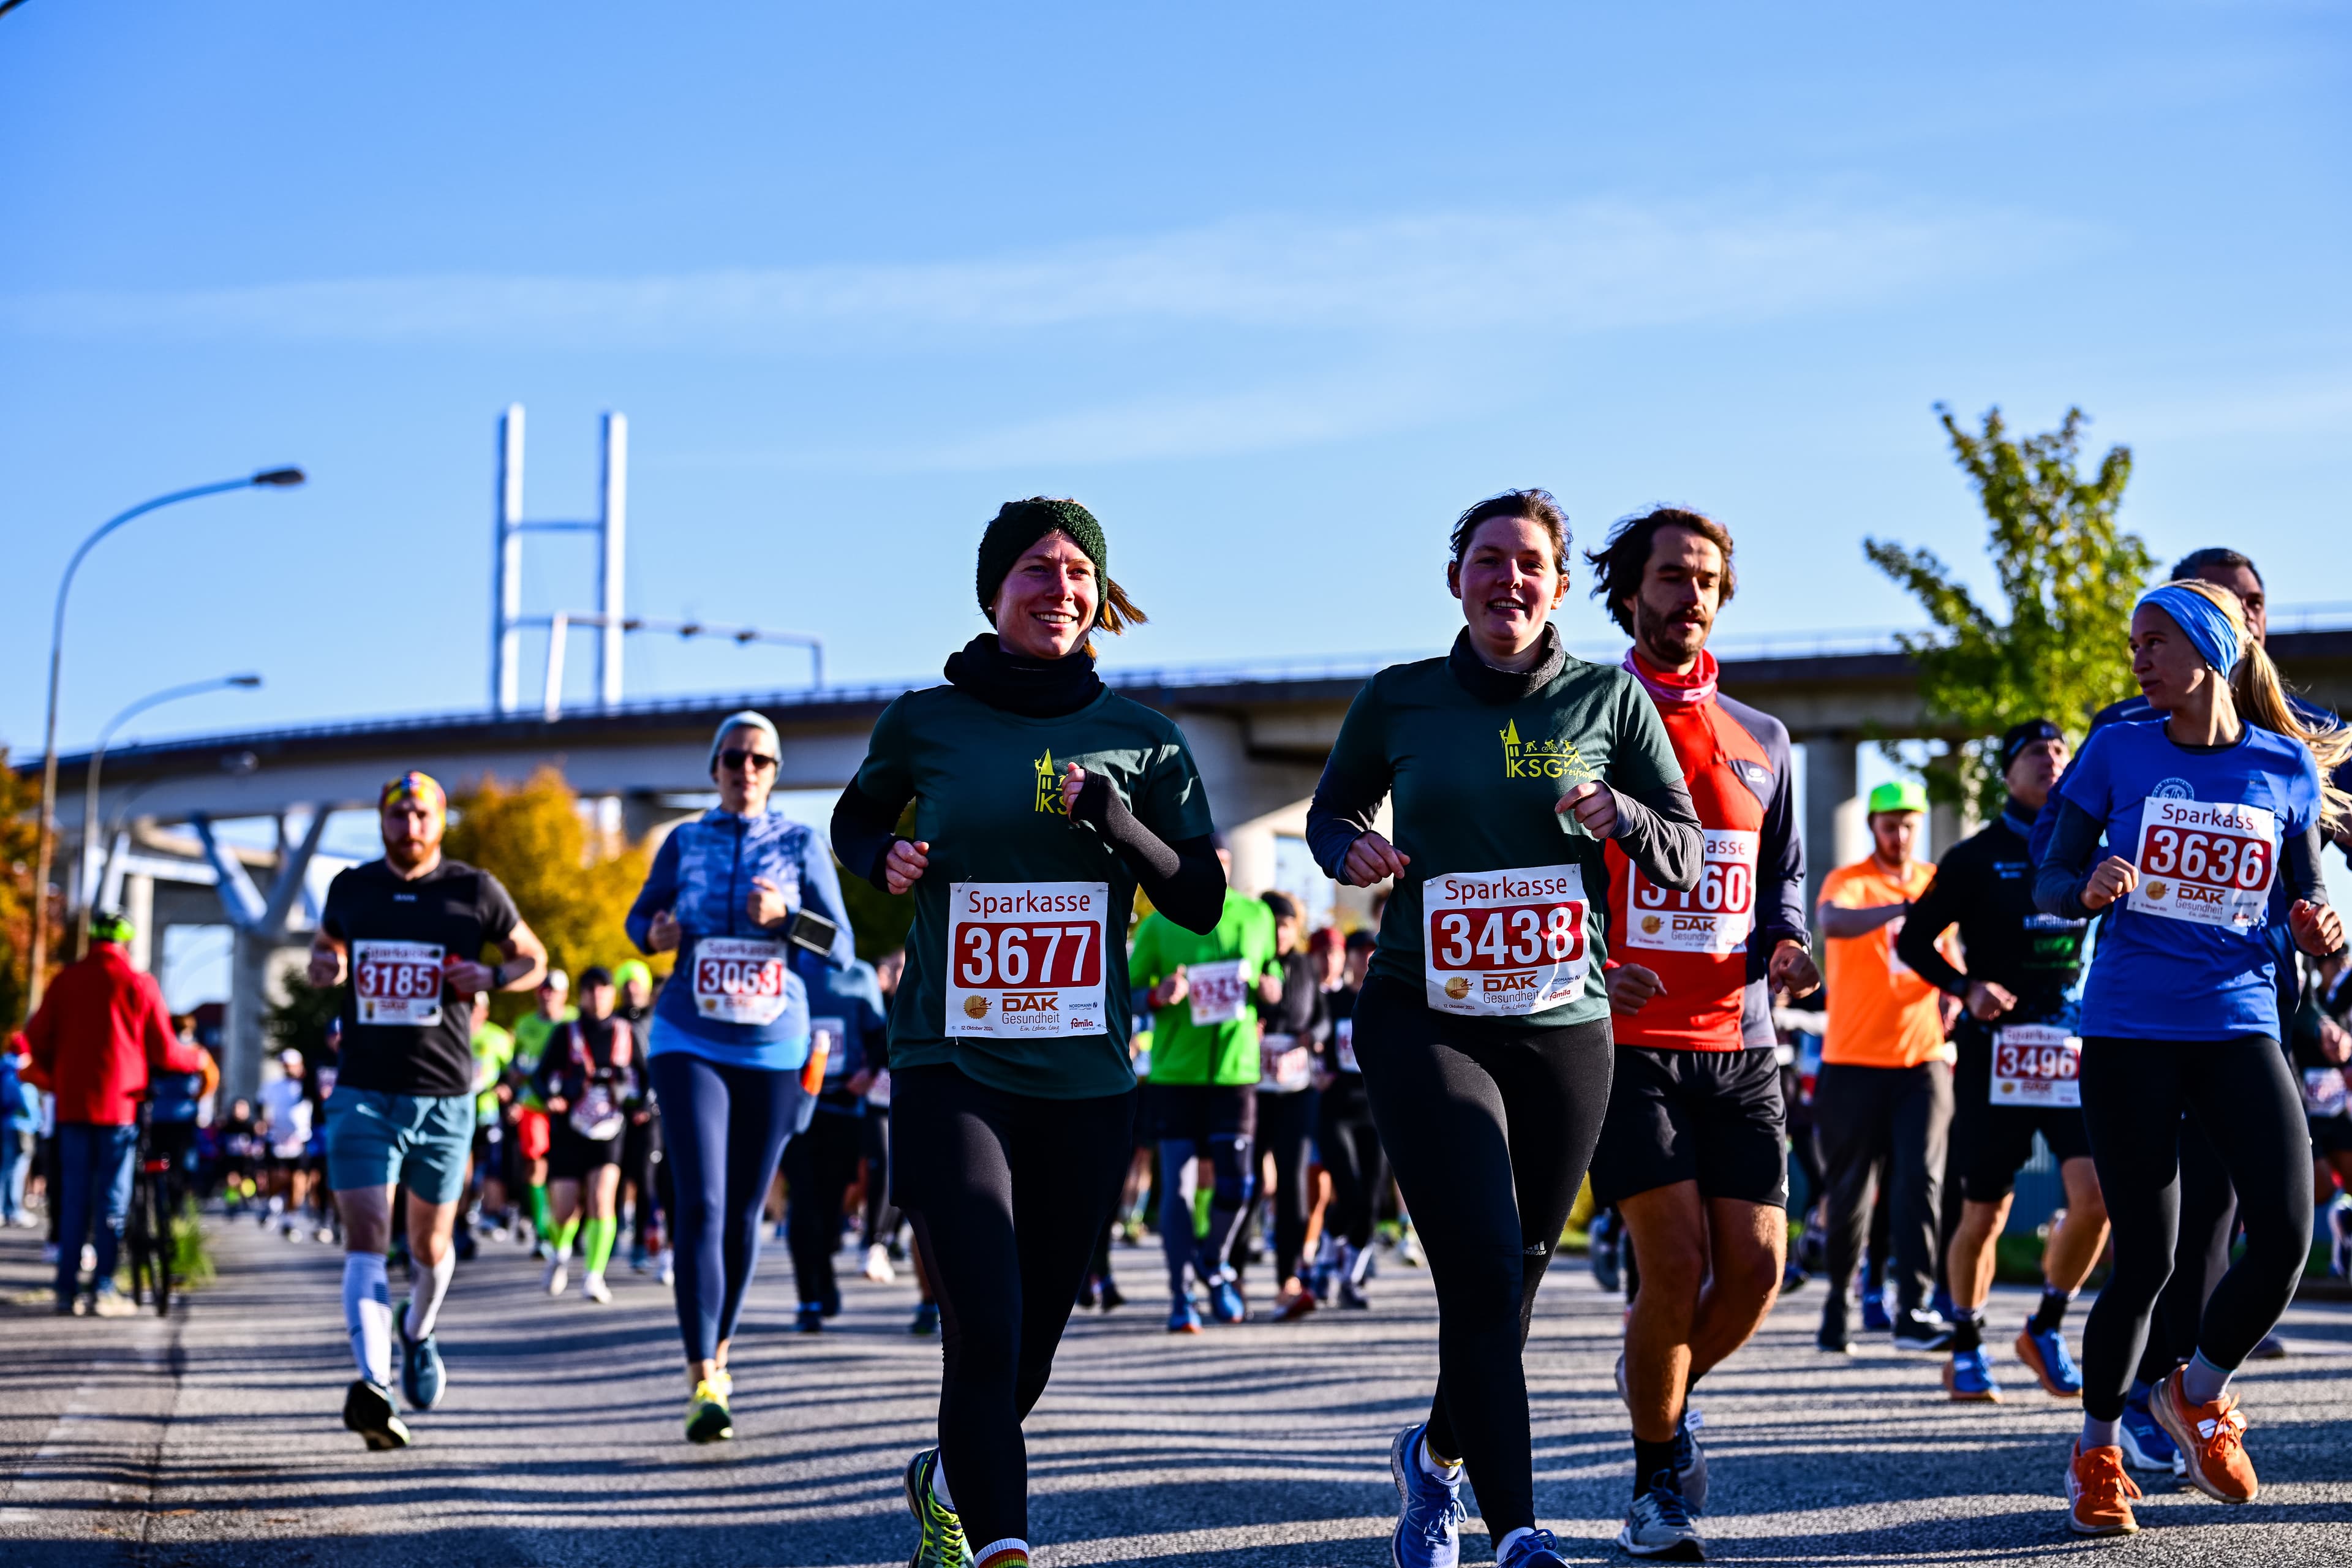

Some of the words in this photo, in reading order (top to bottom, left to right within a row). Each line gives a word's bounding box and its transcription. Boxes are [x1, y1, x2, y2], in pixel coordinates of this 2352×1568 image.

[2162, 804, 2255, 830] Sparkass
[2149, 829, 2264, 888] 3636
[1445, 876, 1567, 905] Sparkasse
[2177, 883, 2226, 905] DAK
[968, 889, 1091, 919] Sparkasse
[2176, 899, 2223, 914] Gesundheit
[1672, 914, 1717, 932] DAK
[1441, 907, 1575, 966] 3438
[1671, 930, 1717, 941] Gesundh
[962, 926, 1091, 984] 3677
[361, 965, 433, 997] 3185
[703, 960, 778, 996] 3063
[1483, 970, 1539, 992] DAK
[1002, 992, 1059, 1011] DAK
[1483, 989, 1539, 1004] Gesundheit
[1550, 989, 1571, 1001] famila
[1002, 1012, 1060, 1024] Gesundheit
[1071, 1017, 1093, 1030] famila
[2000, 1046, 2078, 1079] 3496
